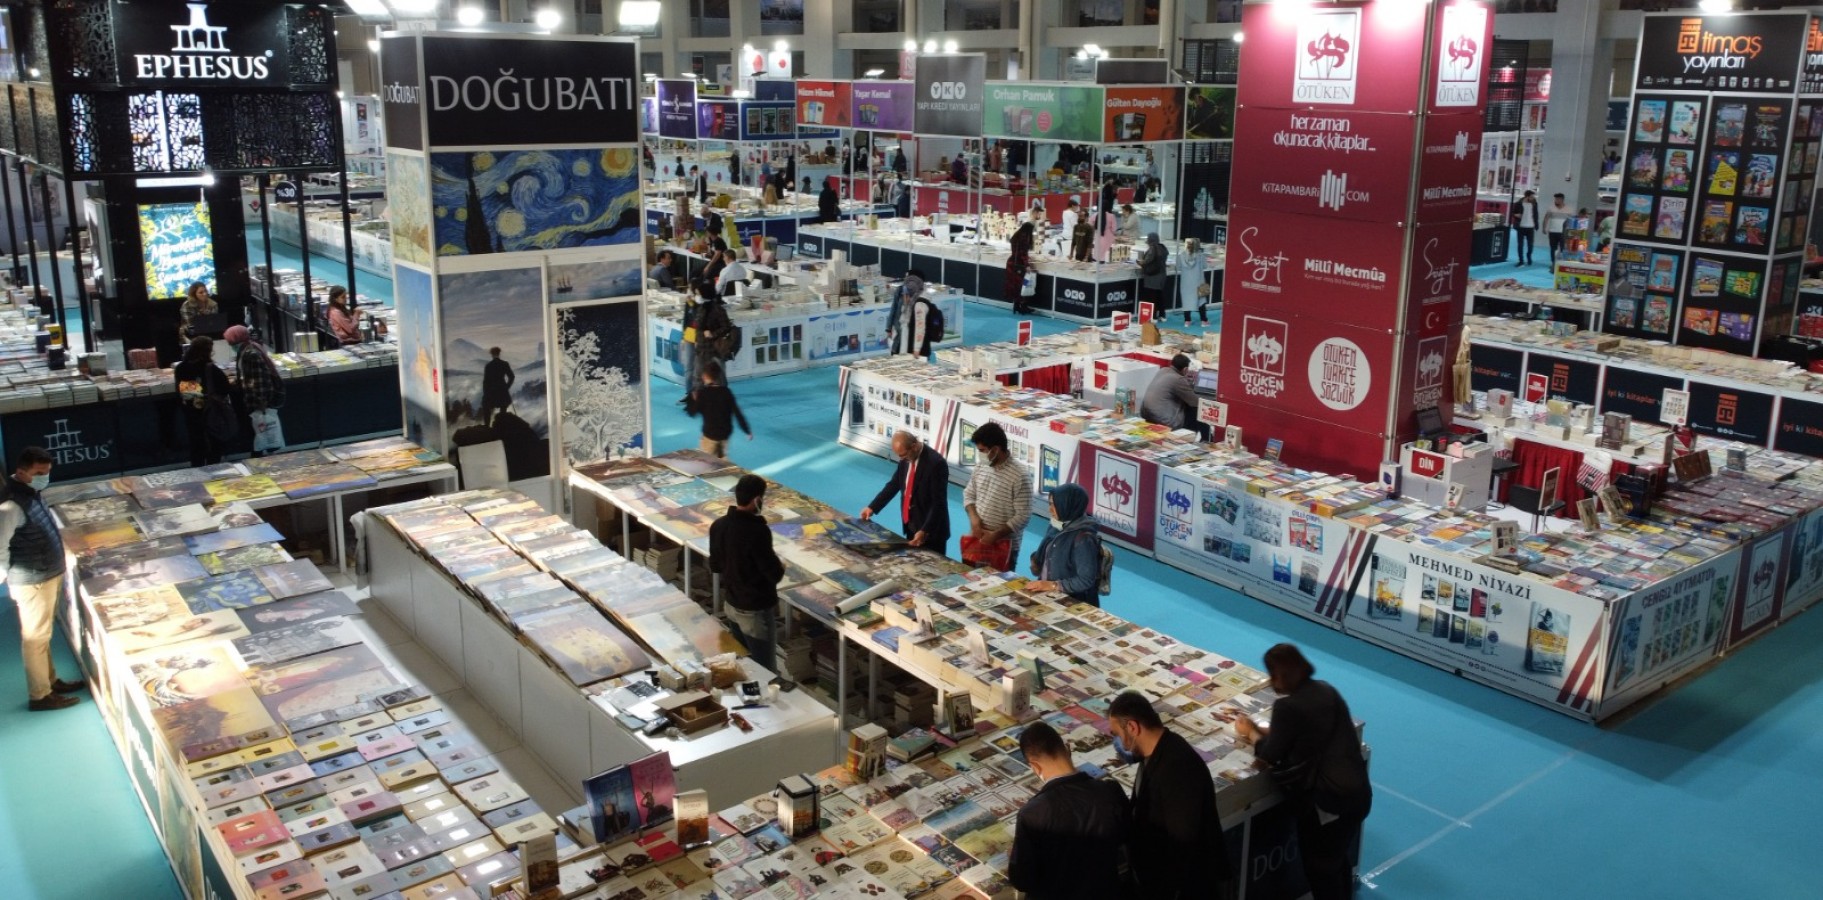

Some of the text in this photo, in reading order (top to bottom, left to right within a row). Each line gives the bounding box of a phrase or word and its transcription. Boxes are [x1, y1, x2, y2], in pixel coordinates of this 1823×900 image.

[1702, 31, 1762, 59] timaş
[134, 54, 269, 80] EPHESUS
[1683, 49, 1745, 74] yayınları
[384, 81, 420, 104] DOĞUBAT
[430, 68, 633, 111] DOĞUBATI
[994, 88, 1055, 102] Orhan Pamuk
[1297, 82, 1351, 99] ÖTÜKEN
[1438, 83, 1476, 102] ÖTÜKEN
[1107, 97, 1162, 109] Gülten Dayıoğlu
[1291, 114, 1350, 132] her zaman
[1274, 130, 1327, 150] okunacak
[1240, 227, 1289, 283] Söğüt
[1333, 262, 1386, 282] Mecmûa
[1324, 343, 1357, 367] ÖTÜKEN
[1240, 369, 1284, 391] ÖTÜKEN
[1323, 362, 1356, 386] TÜRKÇE
[1245, 385, 1277, 399] ÇOCUK
[1320, 382, 1355, 405] SÖZLÜK
[52, 444, 110, 465] HESUS
[1419, 456, 1435, 471] DİN
[1160, 516, 1192, 536] ÖTÜKEN
[1164, 527, 1187, 541] ÇOCUK
[1408, 553, 1474, 583] MEHMED
[1479, 572, 1532, 600] NİYAZİ
